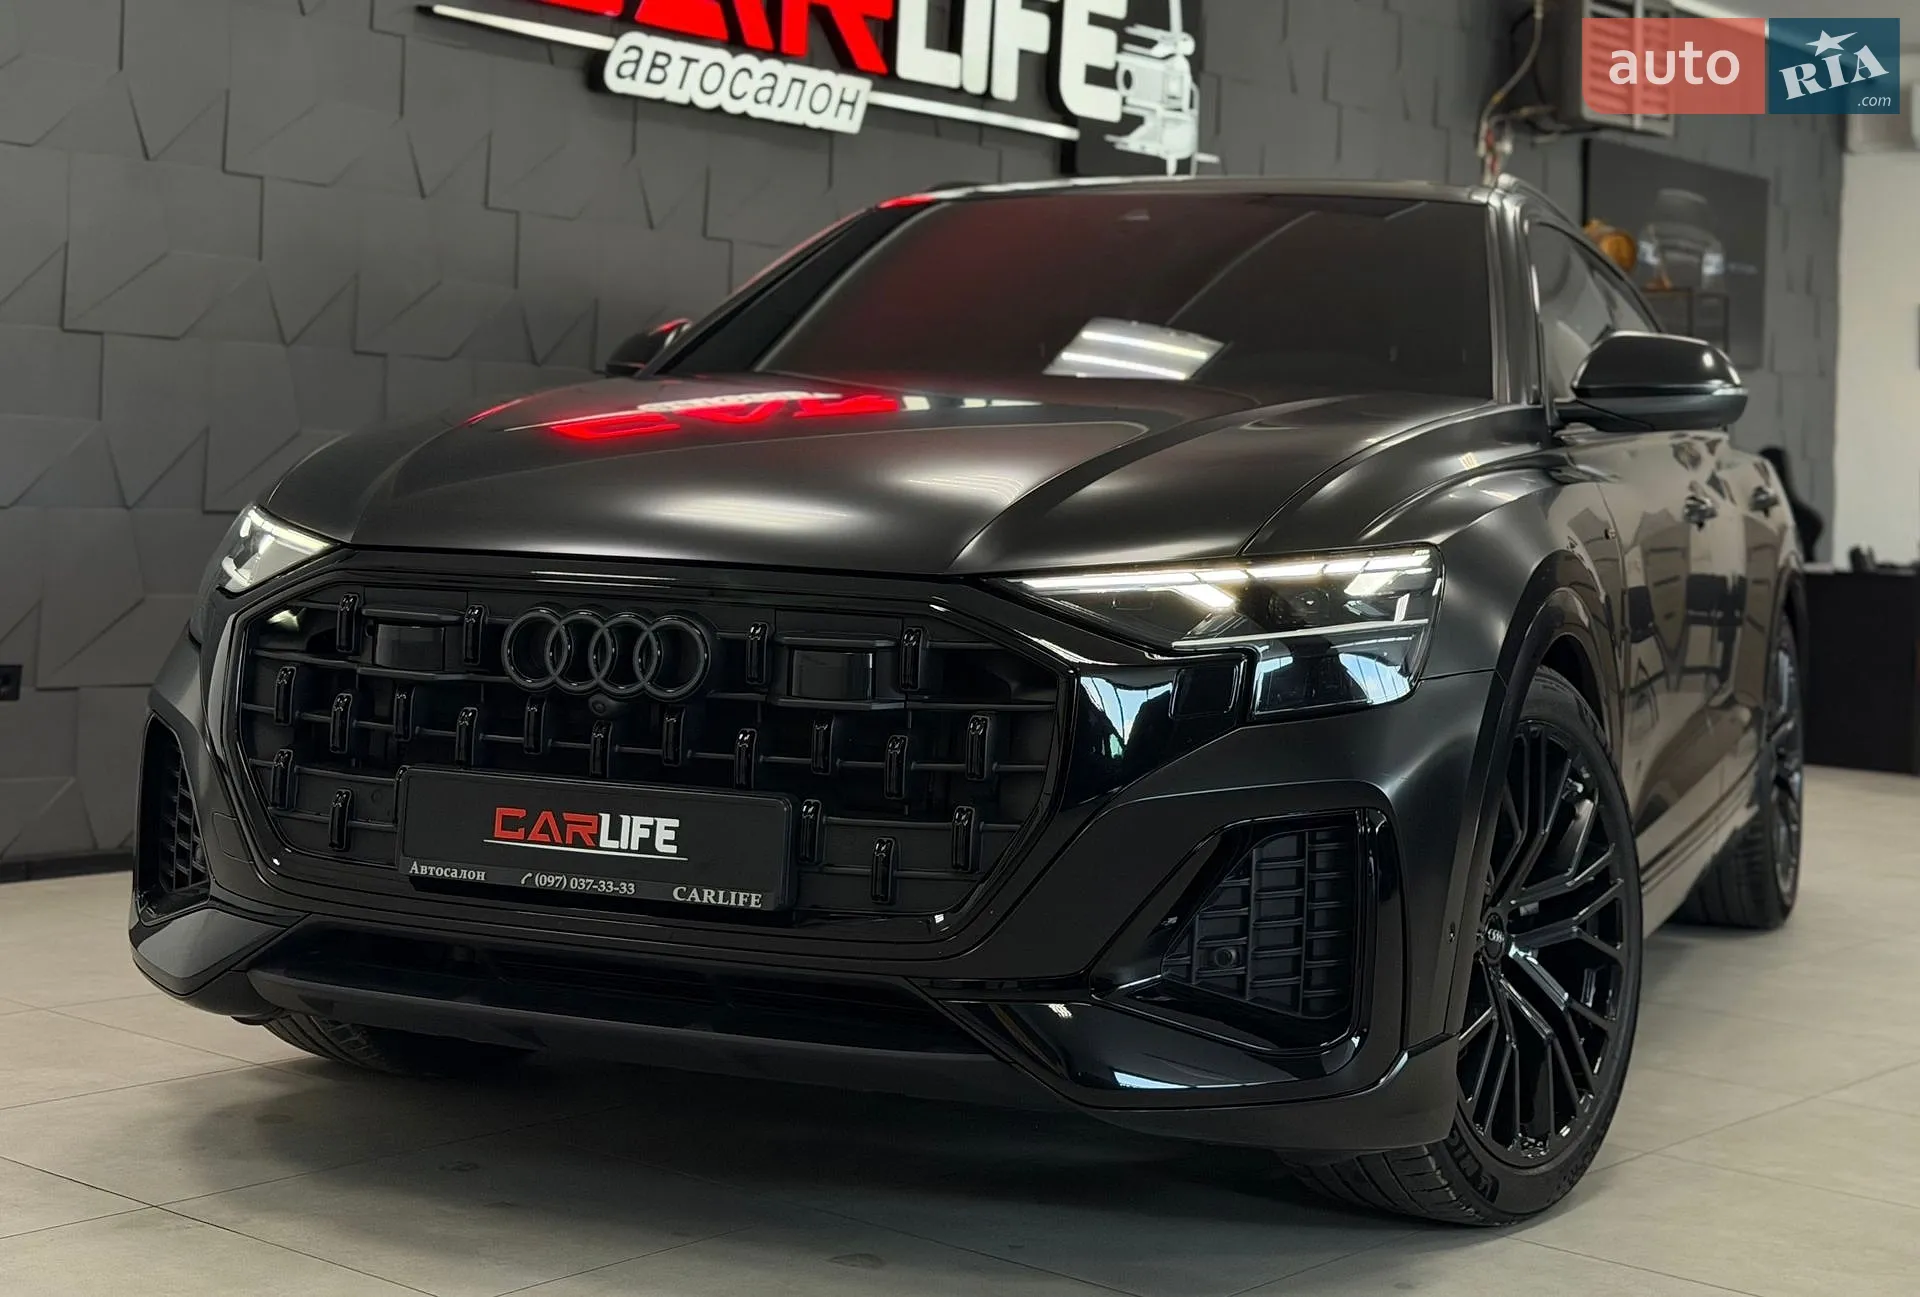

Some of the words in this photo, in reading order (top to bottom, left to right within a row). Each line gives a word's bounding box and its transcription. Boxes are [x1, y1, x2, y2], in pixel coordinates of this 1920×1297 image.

[615, 44, 862, 121] автосалон
[493, 807, 680, 854] CARLIFE
[409, 861, 486, 881] Автосалон
[534, 873, 568, 889] (097)
[569, 876, 636, 895] 037-33-33
[672, 885, 763, 909] CARLIFE
